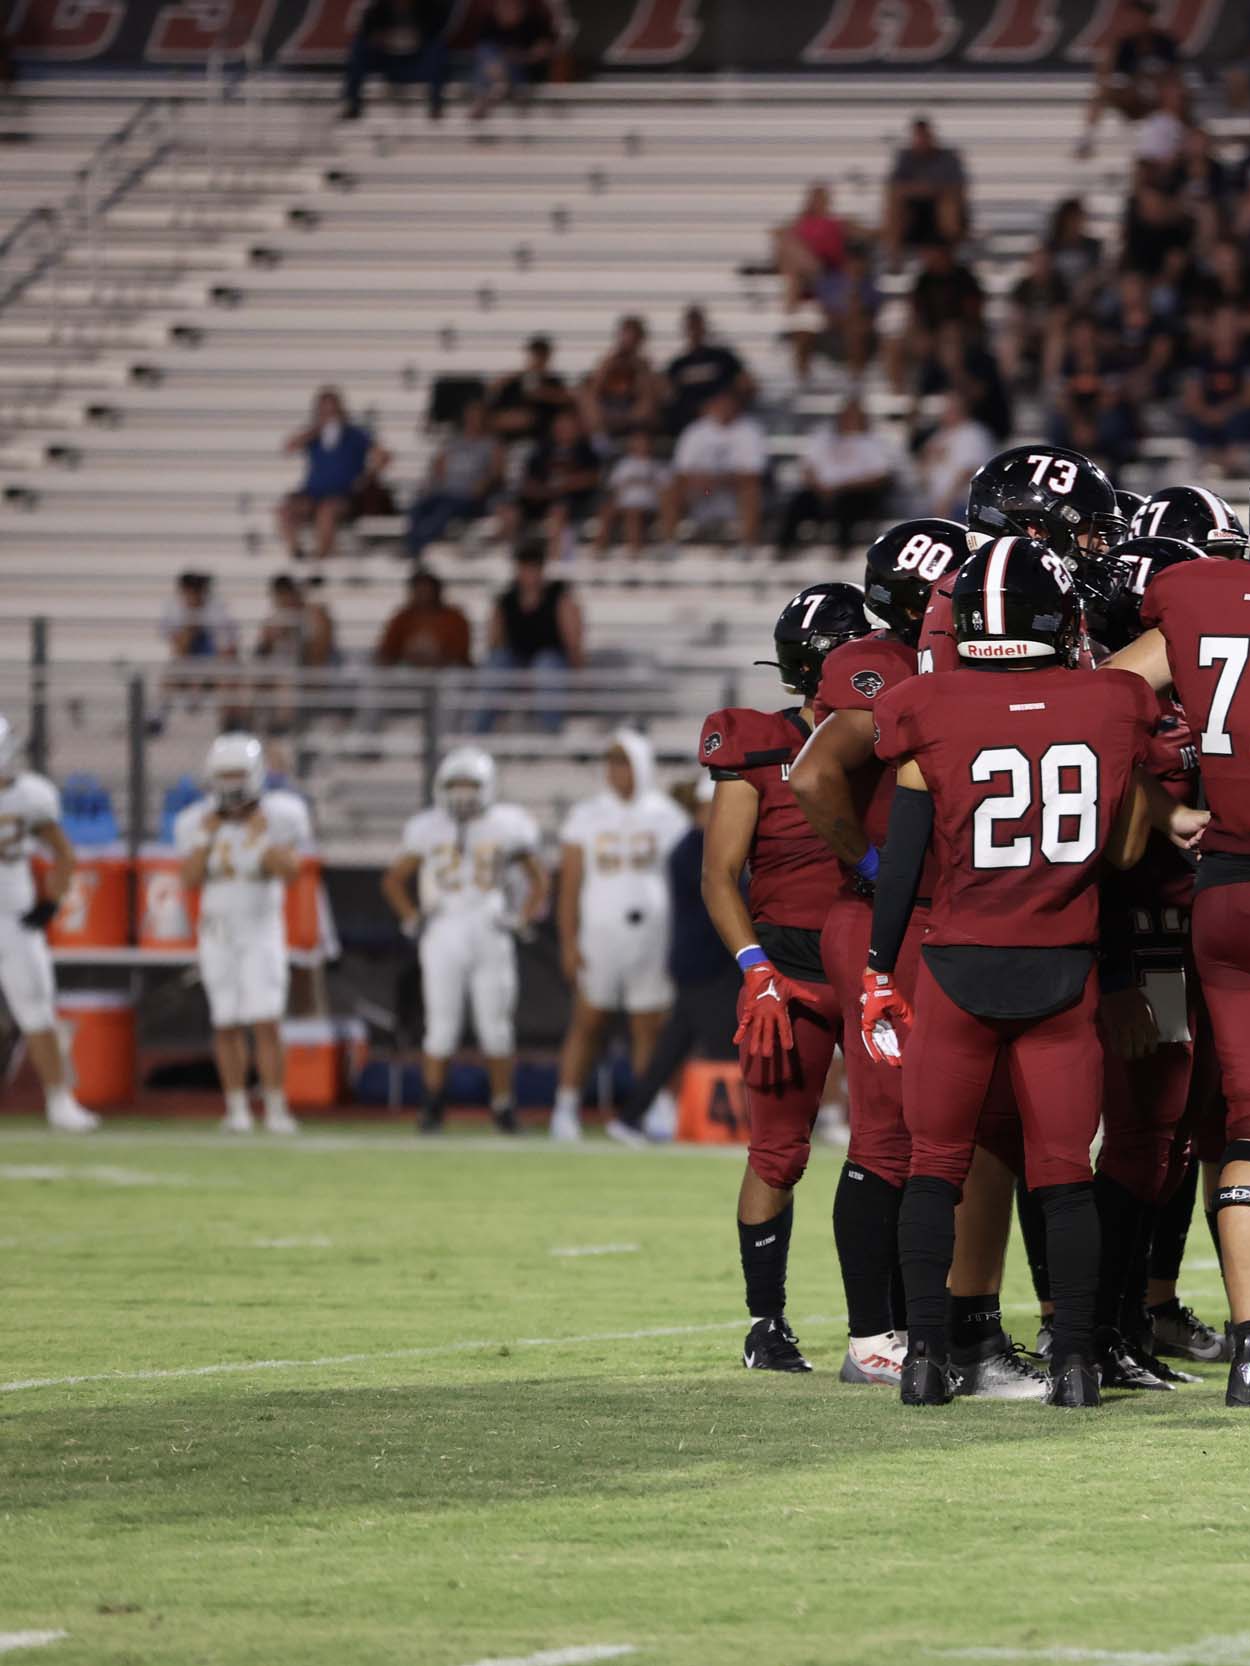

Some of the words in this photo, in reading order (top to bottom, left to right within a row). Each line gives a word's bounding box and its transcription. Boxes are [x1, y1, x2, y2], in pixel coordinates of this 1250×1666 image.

[1027, 455, 1079, 495] 73
[896, 534, 953, 581] 80
[800, 594, 827, 629] 7
[968, 644, 1028, 656] Riddell
[971, 743, 1099, 869] 28
